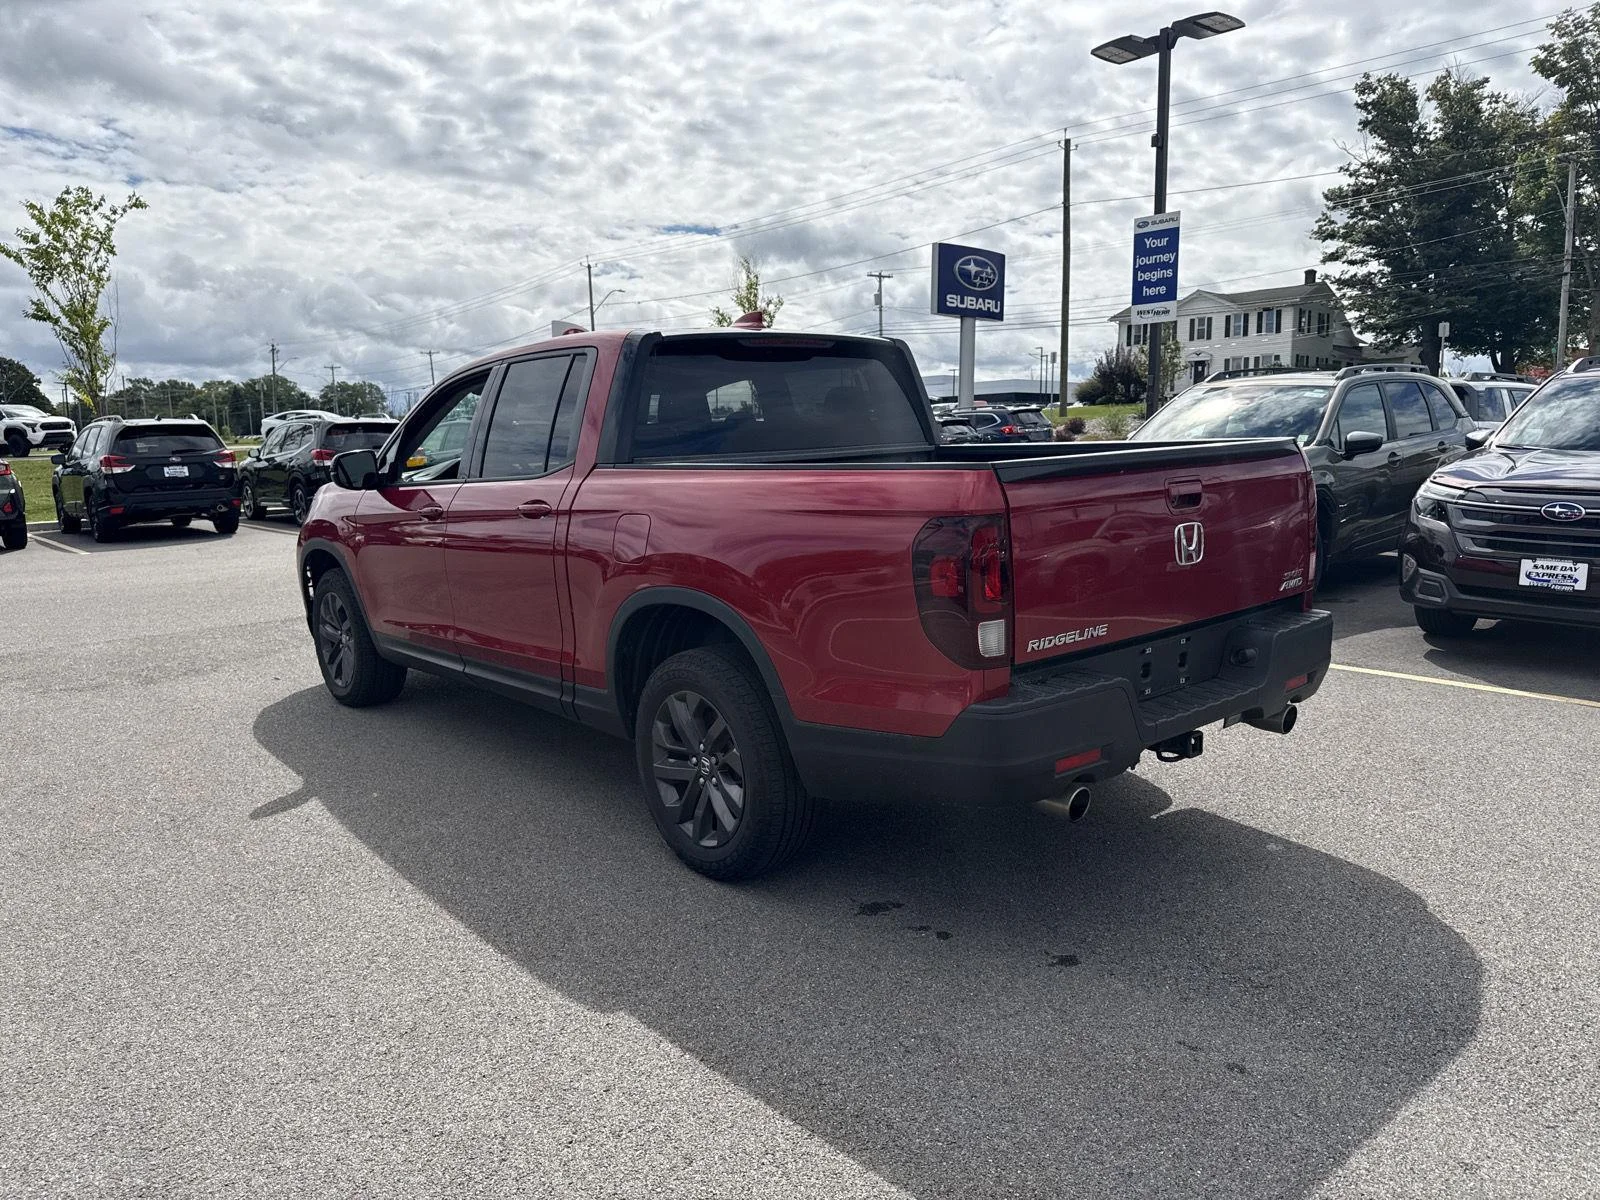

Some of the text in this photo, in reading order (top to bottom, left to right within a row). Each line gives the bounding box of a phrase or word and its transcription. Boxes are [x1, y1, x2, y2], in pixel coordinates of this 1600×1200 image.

[1151, 216, 1179, 226] SUBARU
[1144, 237, 1169, 249] Your
[1135, 252, 1176, 268] journey
[1137, 268, 1173, 282] begins
[1142, 285, 1167, 297] here
[946, 294, 1001, 313] SUBARU
[1532, 563, 1581, 573] SAME DAY
[1528, 571, 1575, 581] EXPRESS
[1026, 623, 1109, 653] RIDGELINE
